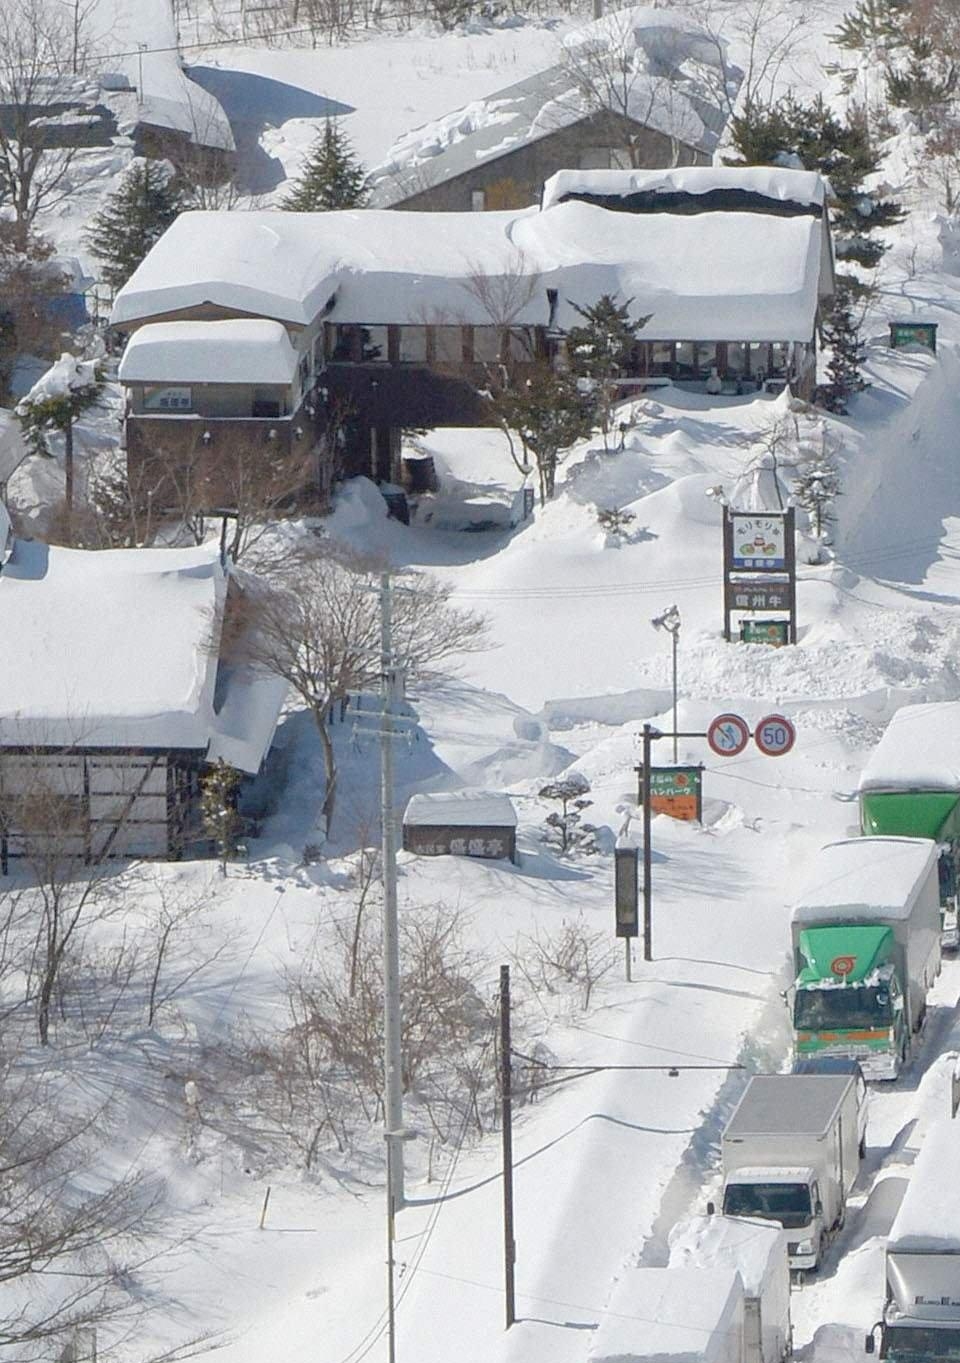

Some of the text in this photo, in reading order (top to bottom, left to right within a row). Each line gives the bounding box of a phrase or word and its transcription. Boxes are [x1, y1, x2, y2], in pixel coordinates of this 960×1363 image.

[735, 594, 782, 607] 信州牛
[763, 728, 786, 745] 50
